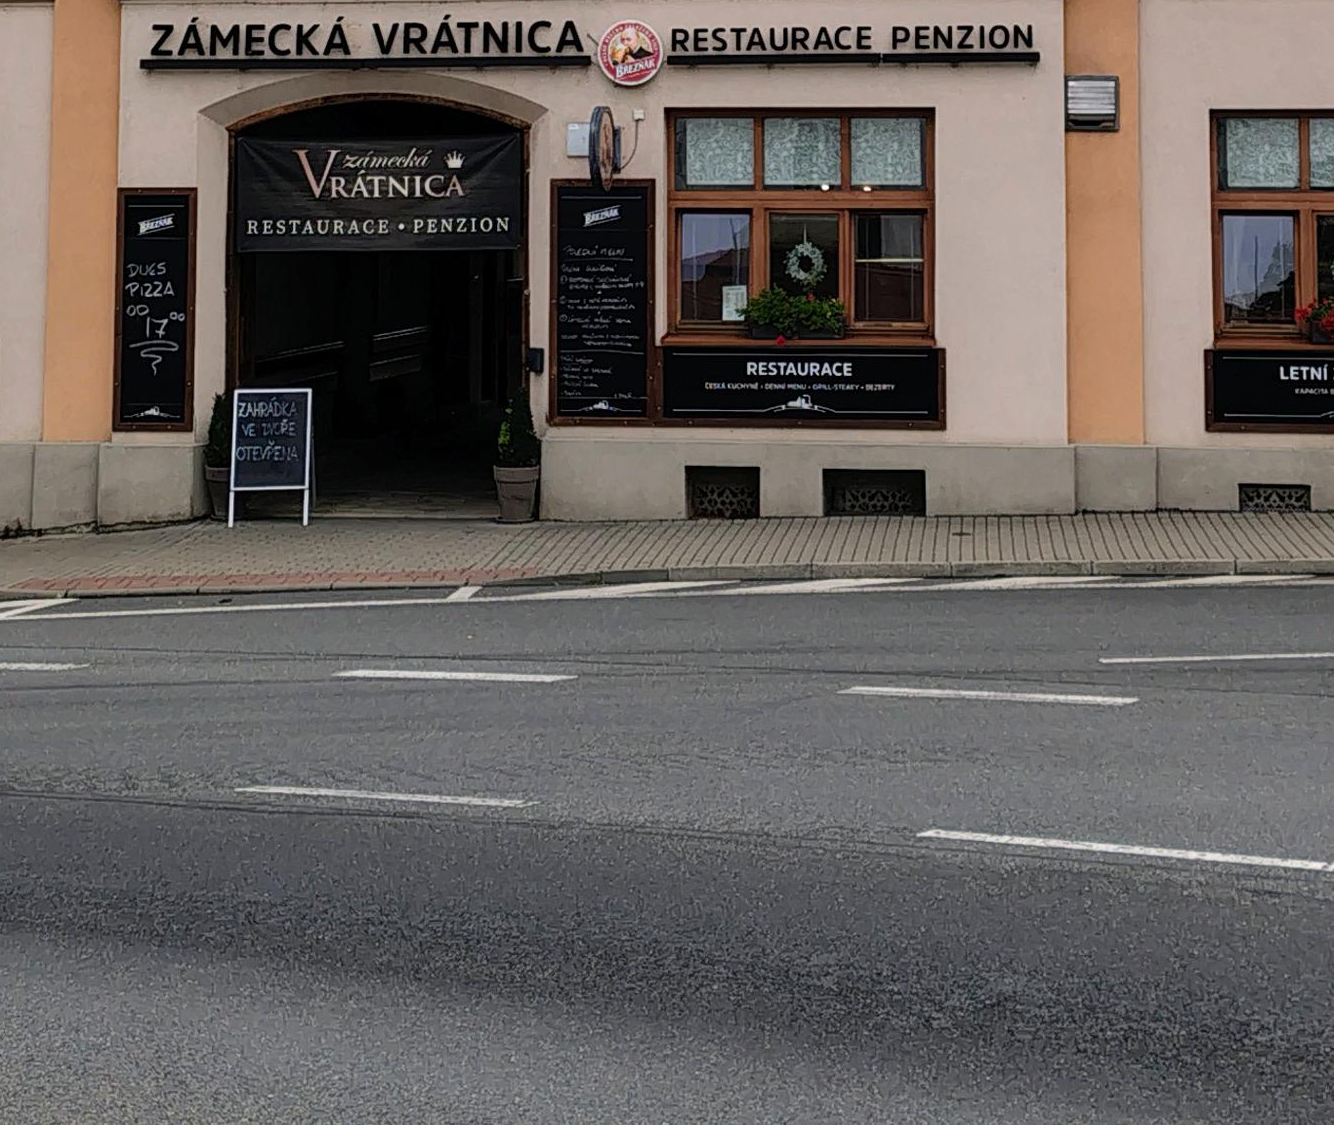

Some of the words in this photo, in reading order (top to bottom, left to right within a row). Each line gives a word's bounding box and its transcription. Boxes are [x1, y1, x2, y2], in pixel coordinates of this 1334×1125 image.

[150, 16, 351, 56] ZÁMECKÁ
[372, 14, 584, 55] VRÁTNICA
[671, 26, 873, 52] RESTAURACE
[891, 25, 1034, 50] PENZION
[342, 148, 433, 169] zámecká
[246, 219, 390, 236] RESTAURACE
[413, 217, 510, 235] PENZION
[125, 281, 175, 297] PIZZA
[746, 361, 853, 376] RESTAURACE
[1279, 363, 1329, 381] LETNÍ
